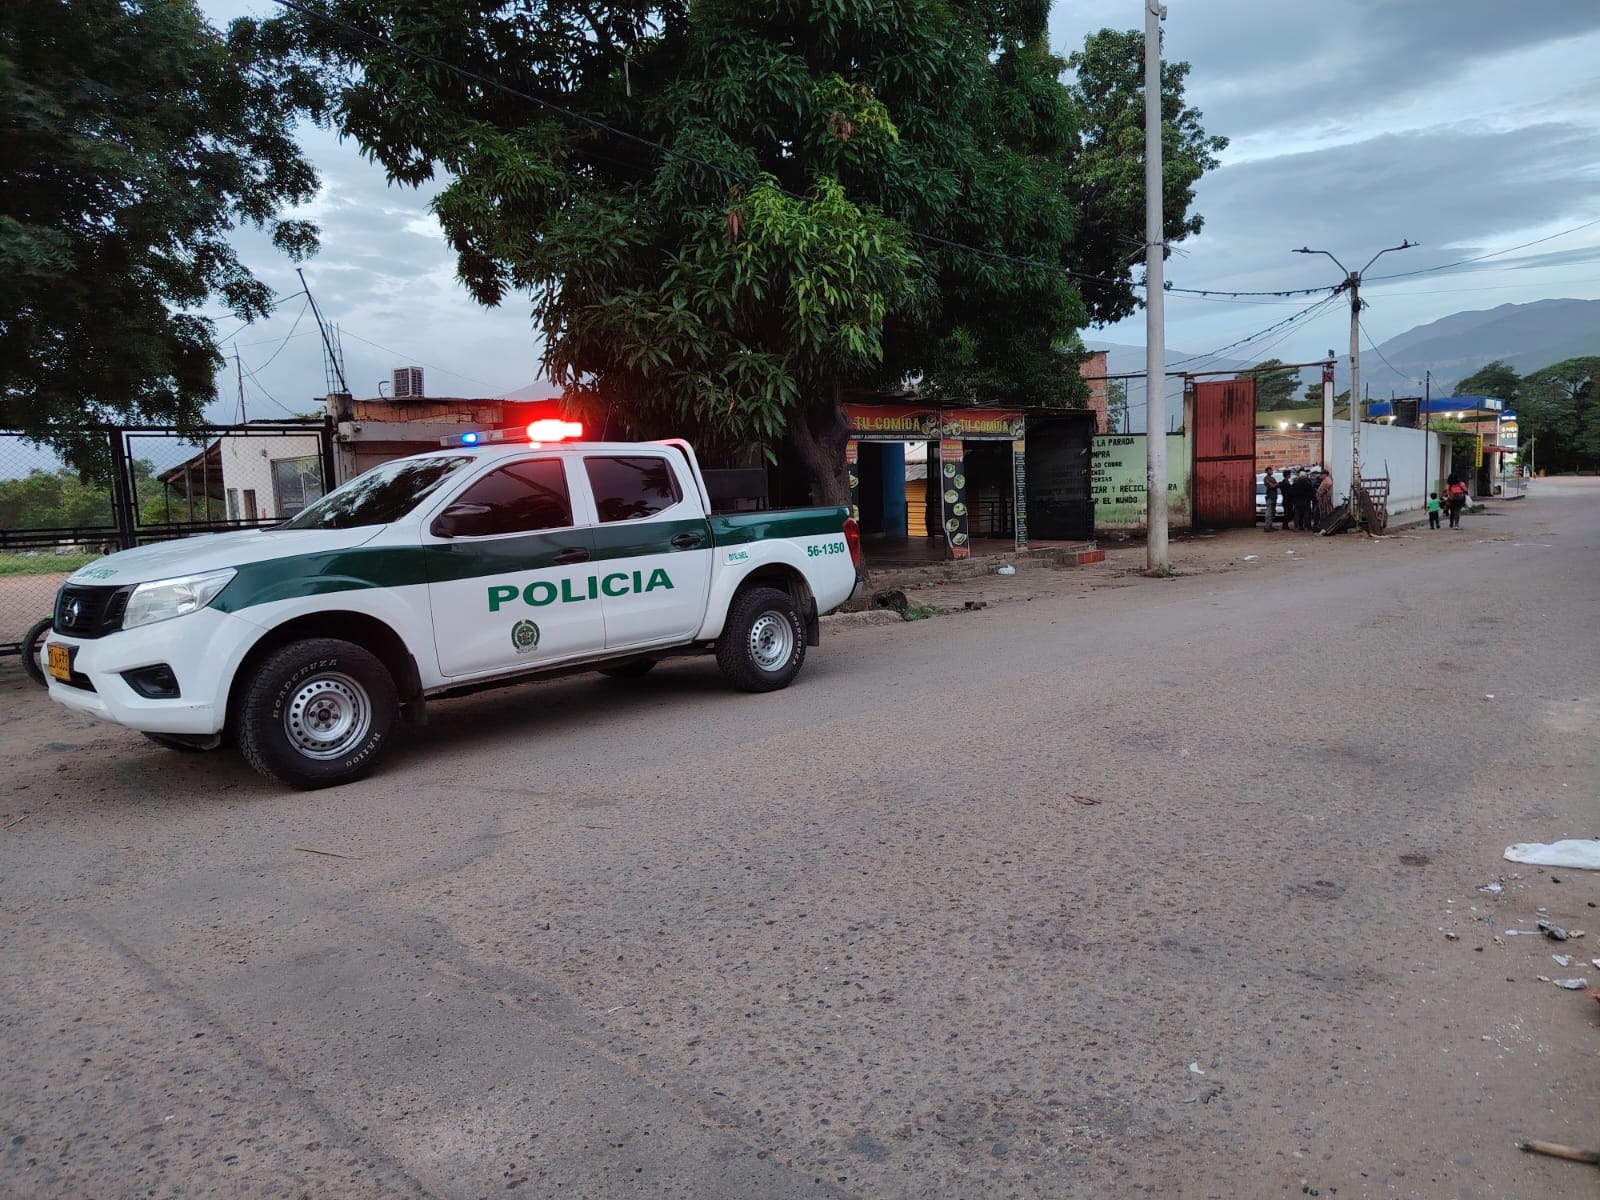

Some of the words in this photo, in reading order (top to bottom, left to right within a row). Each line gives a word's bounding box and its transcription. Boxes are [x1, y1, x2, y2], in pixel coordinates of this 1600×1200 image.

[855, 416, 870, 430] TU
[875, 416, 921, 431] COMIDA
[975, 420, 1009, 432] COMIDA
[1096, 439, 1106, 447] LA
[1108, 437, 1135, 446] PARADA
[1091, 486, 1108, 494] IZAR
[1119, 484, 1147, 493] RECICL
[1102, 497, 1112, 505] EL
[1115, 496, 1138, 504] MUNDO
[807, 542, 845, 557] 56-1350
[487, 567, 675, 612] POLICIA
[272, 658, 338, 719] ROADCRUZA
